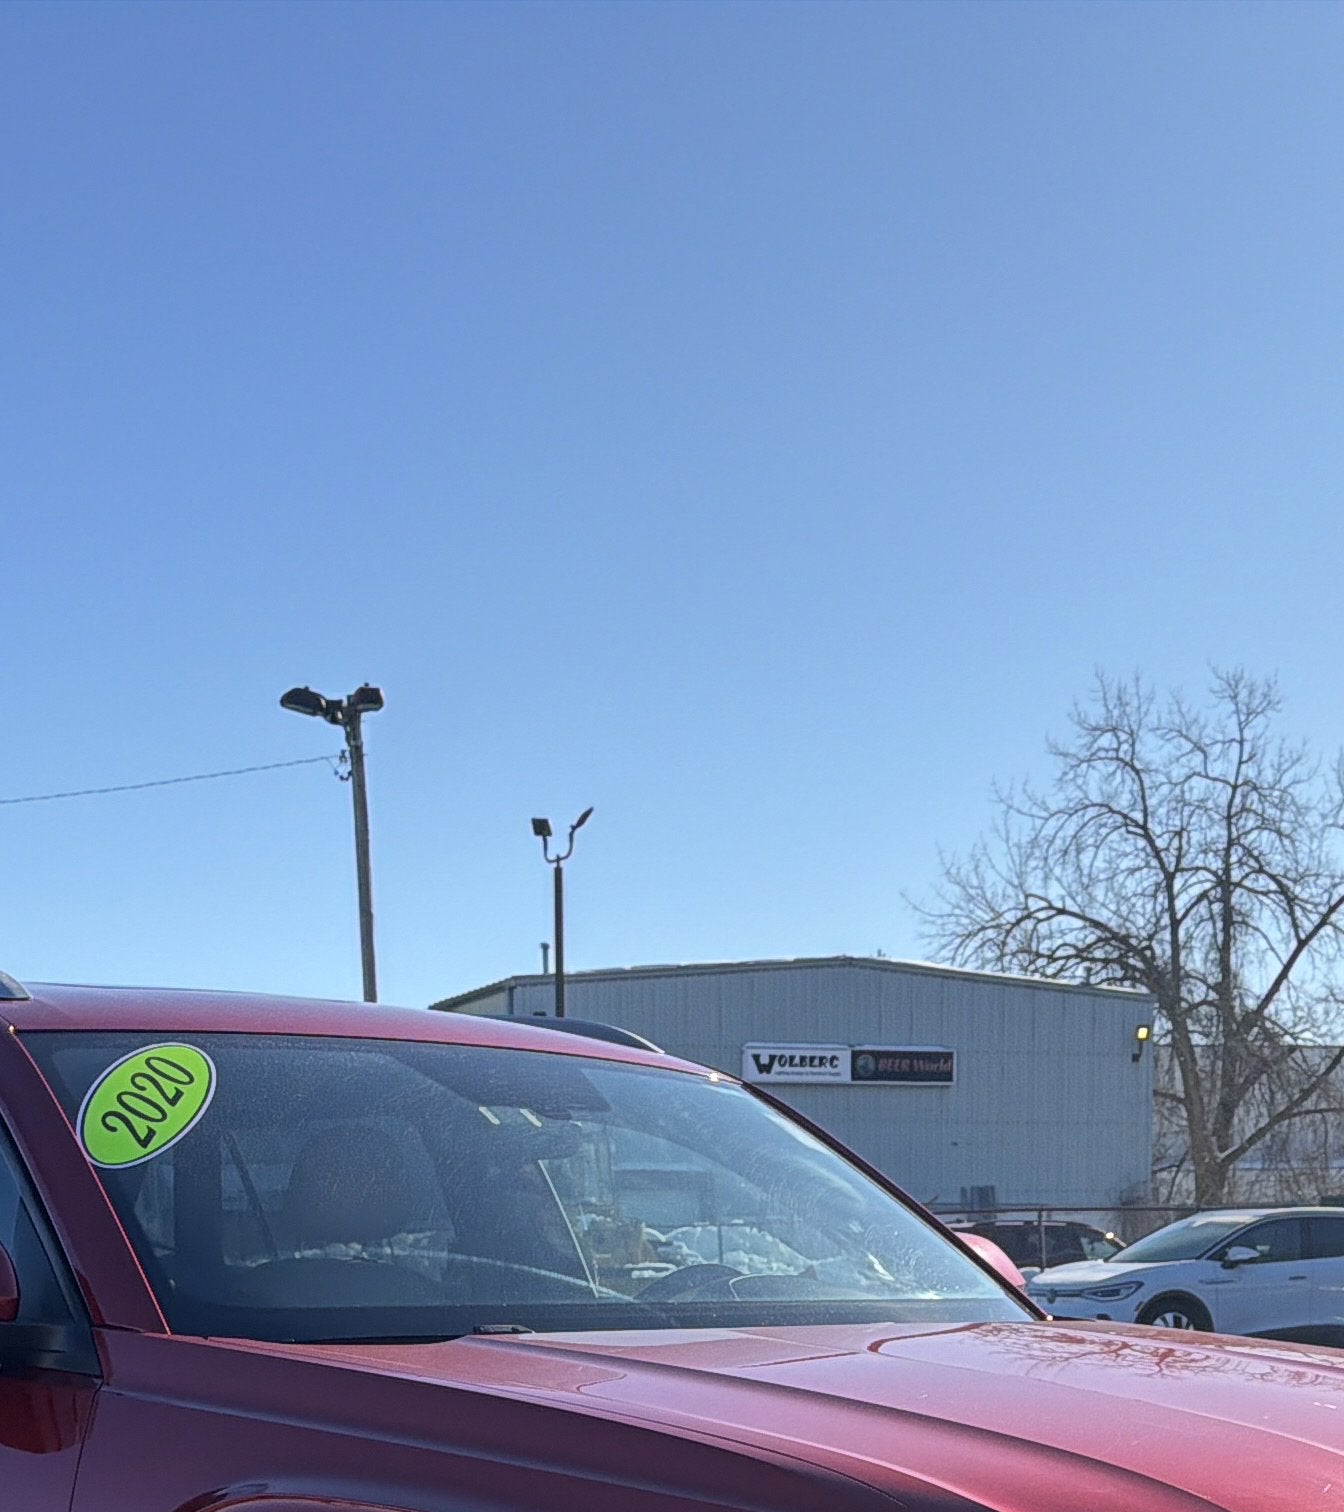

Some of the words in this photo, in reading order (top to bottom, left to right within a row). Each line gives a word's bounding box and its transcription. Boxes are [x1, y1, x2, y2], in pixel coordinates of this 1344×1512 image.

[878, 1057, 910, 1072] BEER
[912, 1057, 952, 1073] World
[101, 1056, 195, 1149] 2020
